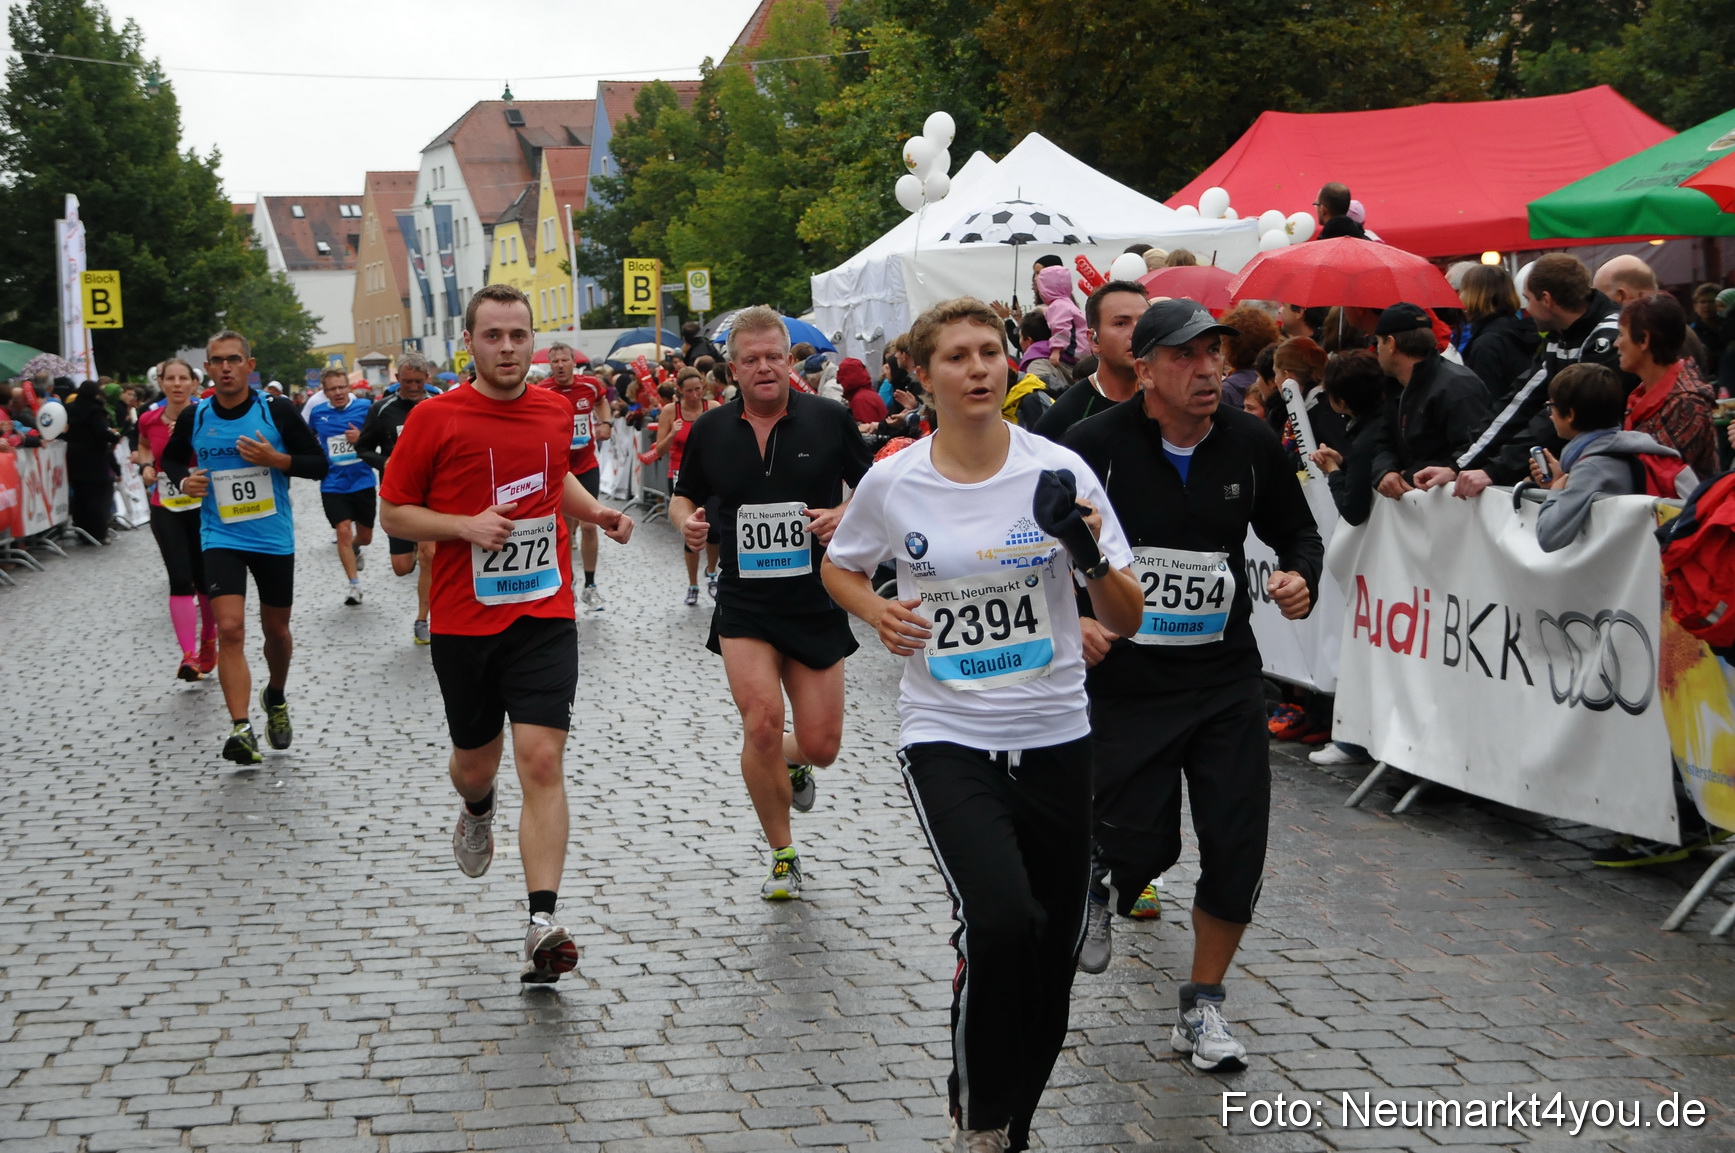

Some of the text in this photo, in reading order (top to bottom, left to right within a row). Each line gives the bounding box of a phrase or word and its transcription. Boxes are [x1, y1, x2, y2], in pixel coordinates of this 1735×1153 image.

[628, 261, 657, 271] Block
[84, 274, 116, 284] Block
[634, 276, 651, 301] B
[91, 289, 112, 315] B
[232, 481, 257, 501] 69
[510, 482, 532, 496] DEHN
[233, 505, 261, 515] Roland
[759, 510, 796, 519] Neumarkt
[509, 528, 545, 538] eumarkt
[742, 520, 805, 550] 3048
[482, 537, 550, 573] 2272
[756, 556, 792, 568] werner
[976, 549, 998, 560] 14.
[1133, 555, 1168, 568] PARTL
[497, 576, 540, 592] Michael
[920, 580, 1021, 603] PARTL Neumarkt
[1140, 571, 1225, 611] 2554
[934, 594, 1038, 649] 2394
[1152, 617, 1204, 633] Thomas
[1353, 575, 1535, 687] Audi BKK
[960, 652, 1022, 676] Claudia
